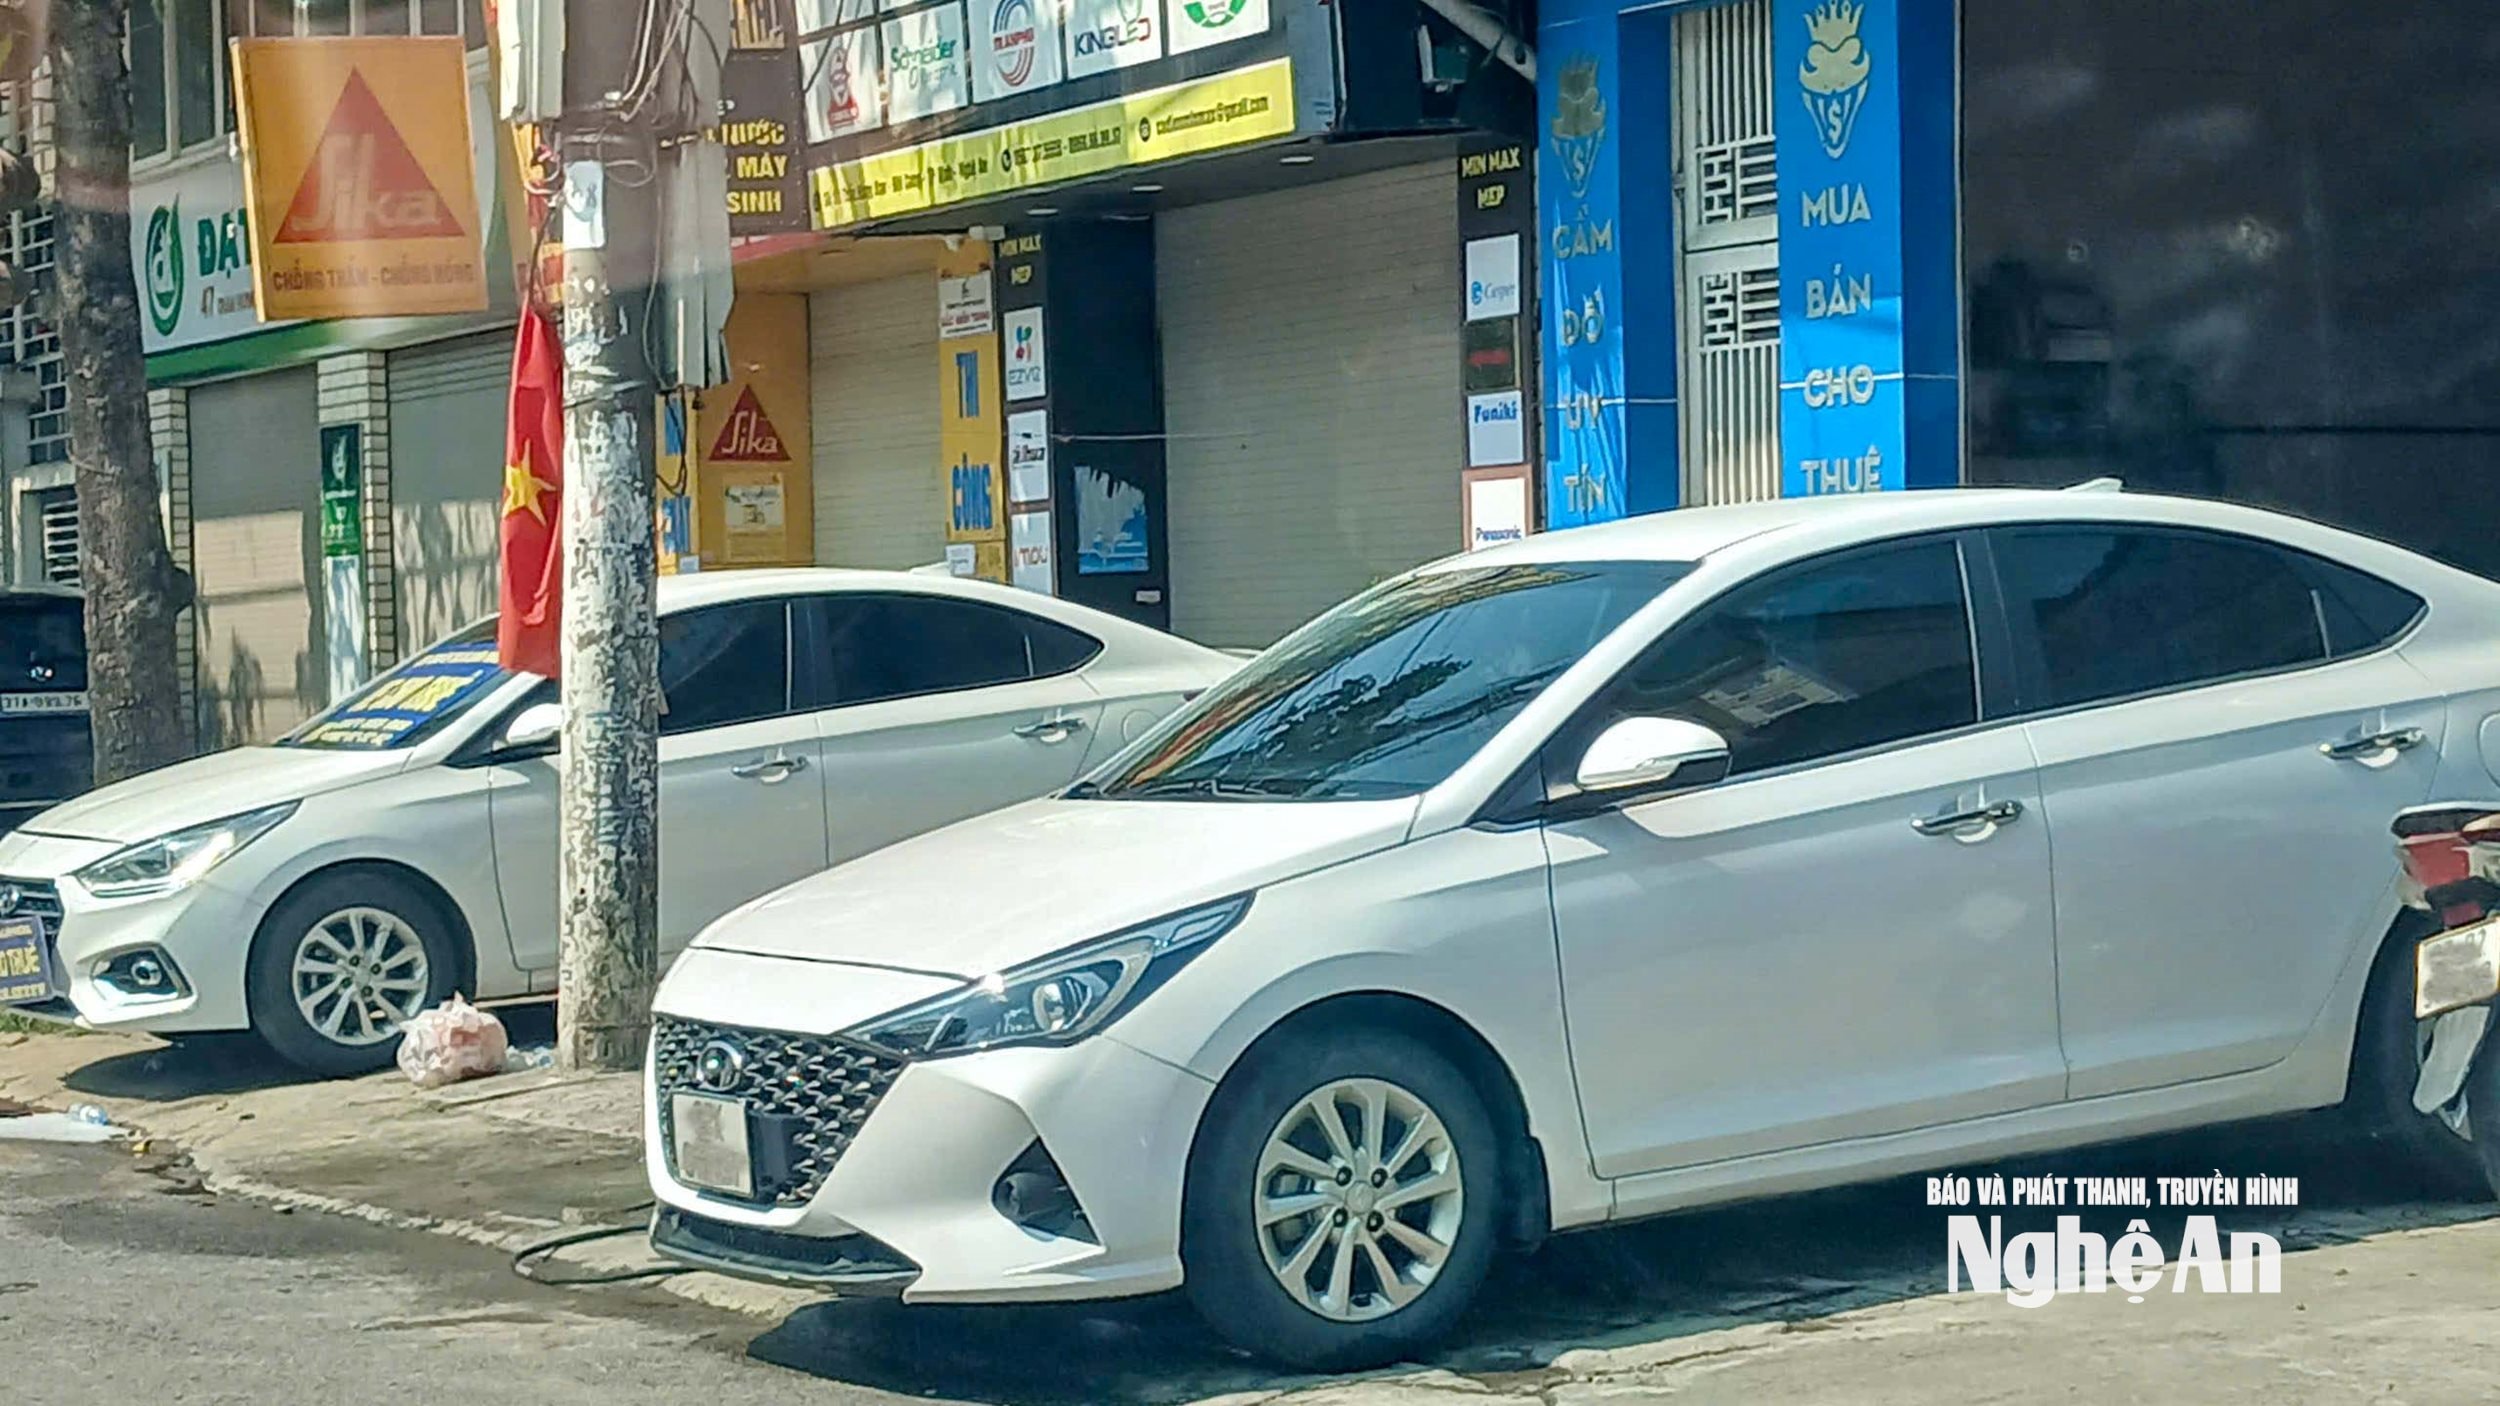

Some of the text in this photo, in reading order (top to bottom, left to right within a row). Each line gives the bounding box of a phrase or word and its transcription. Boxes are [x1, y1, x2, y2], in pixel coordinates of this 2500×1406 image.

[291, 132, 439, 233] Sika
[736, 152, 788, 179] MÁY
[1461, 148, 1520, 178] MIN MAX
[726, 190, 782, 214] SINH
[1477, 184, 1505, 209] MEP
[1801, 182, 1871, 227] MUA
[1552, 203, 1613, 259] CẦM
[1805, 262, 1871, 319] BÁN
[1802, 363, 1875, 408] CHO
[721, 410, 778, 454] Sika
[1474, 401, 1518, 424] Funiki
[1564, 463, 1608, 514] TÍN
[1800, 445, 1882, 494] THUÊ
